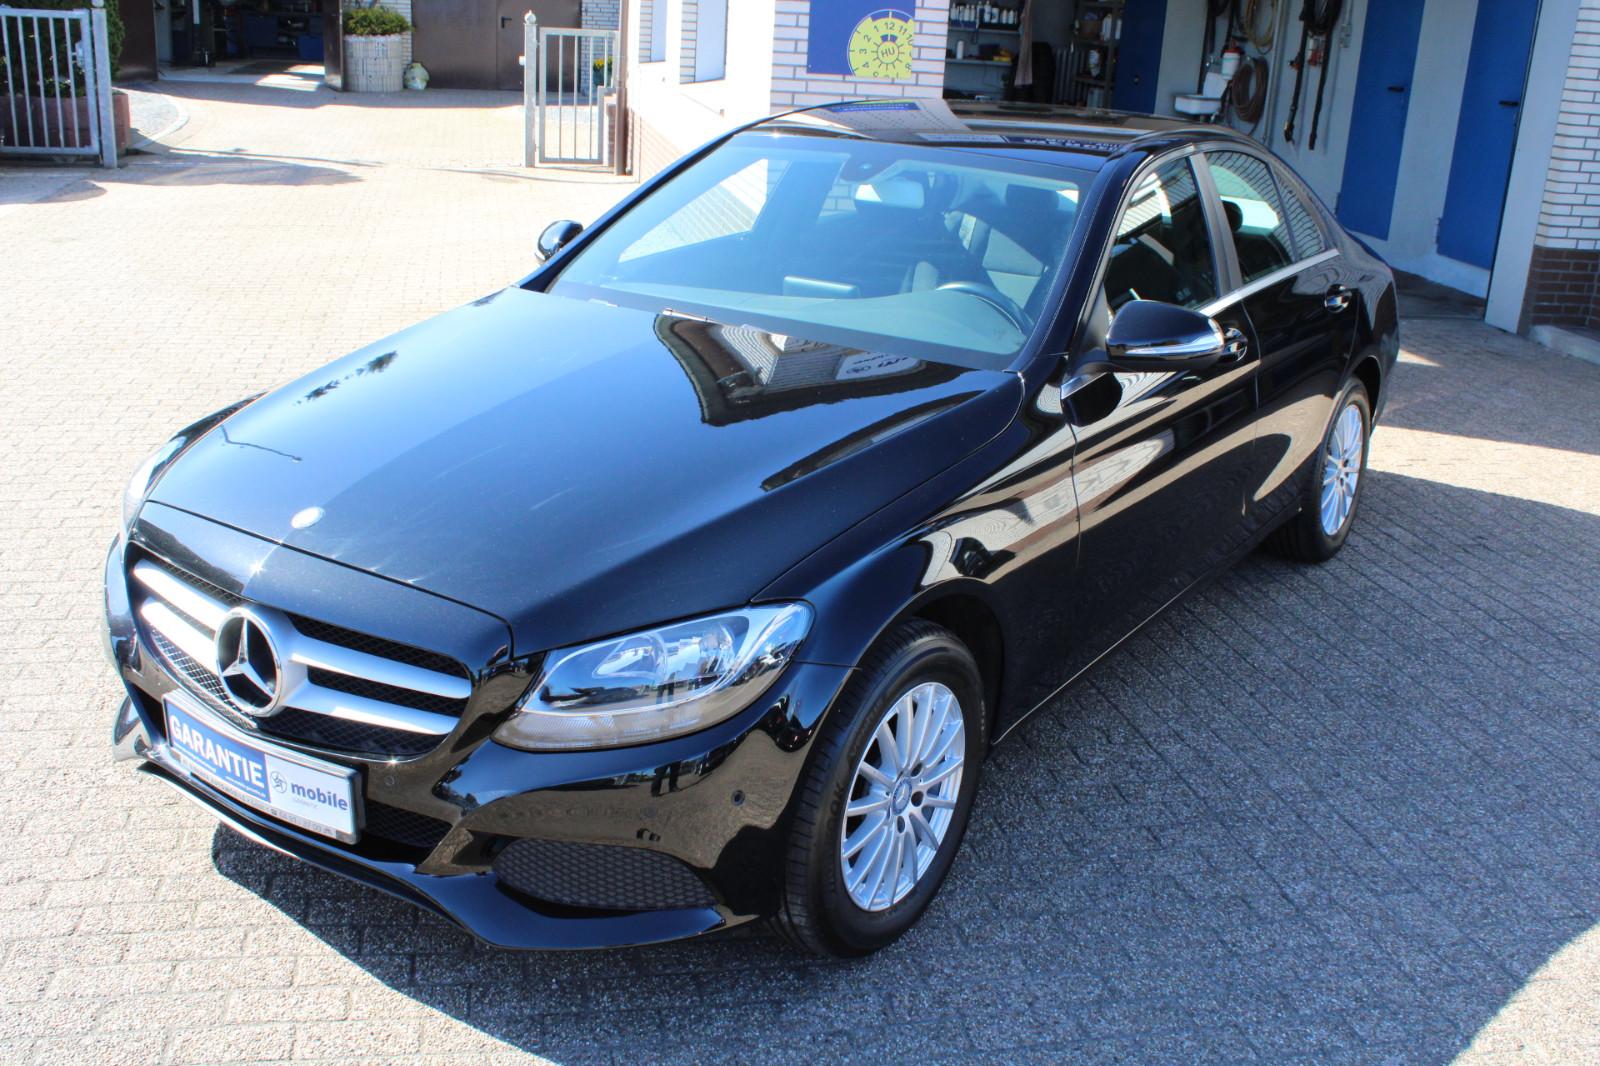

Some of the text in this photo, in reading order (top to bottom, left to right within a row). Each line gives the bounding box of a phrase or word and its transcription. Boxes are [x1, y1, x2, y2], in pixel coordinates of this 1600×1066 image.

[884, 21, 896, 31] 12
[899, 25, 908, 35] 11
[863, 34, 872, 42] 2
[880, 47, 896, 58] HU
[862, 61, 870, 69] 4
[168, 714, 266, 790] GARANTIE
[290, 782, 348, 811] mobile
